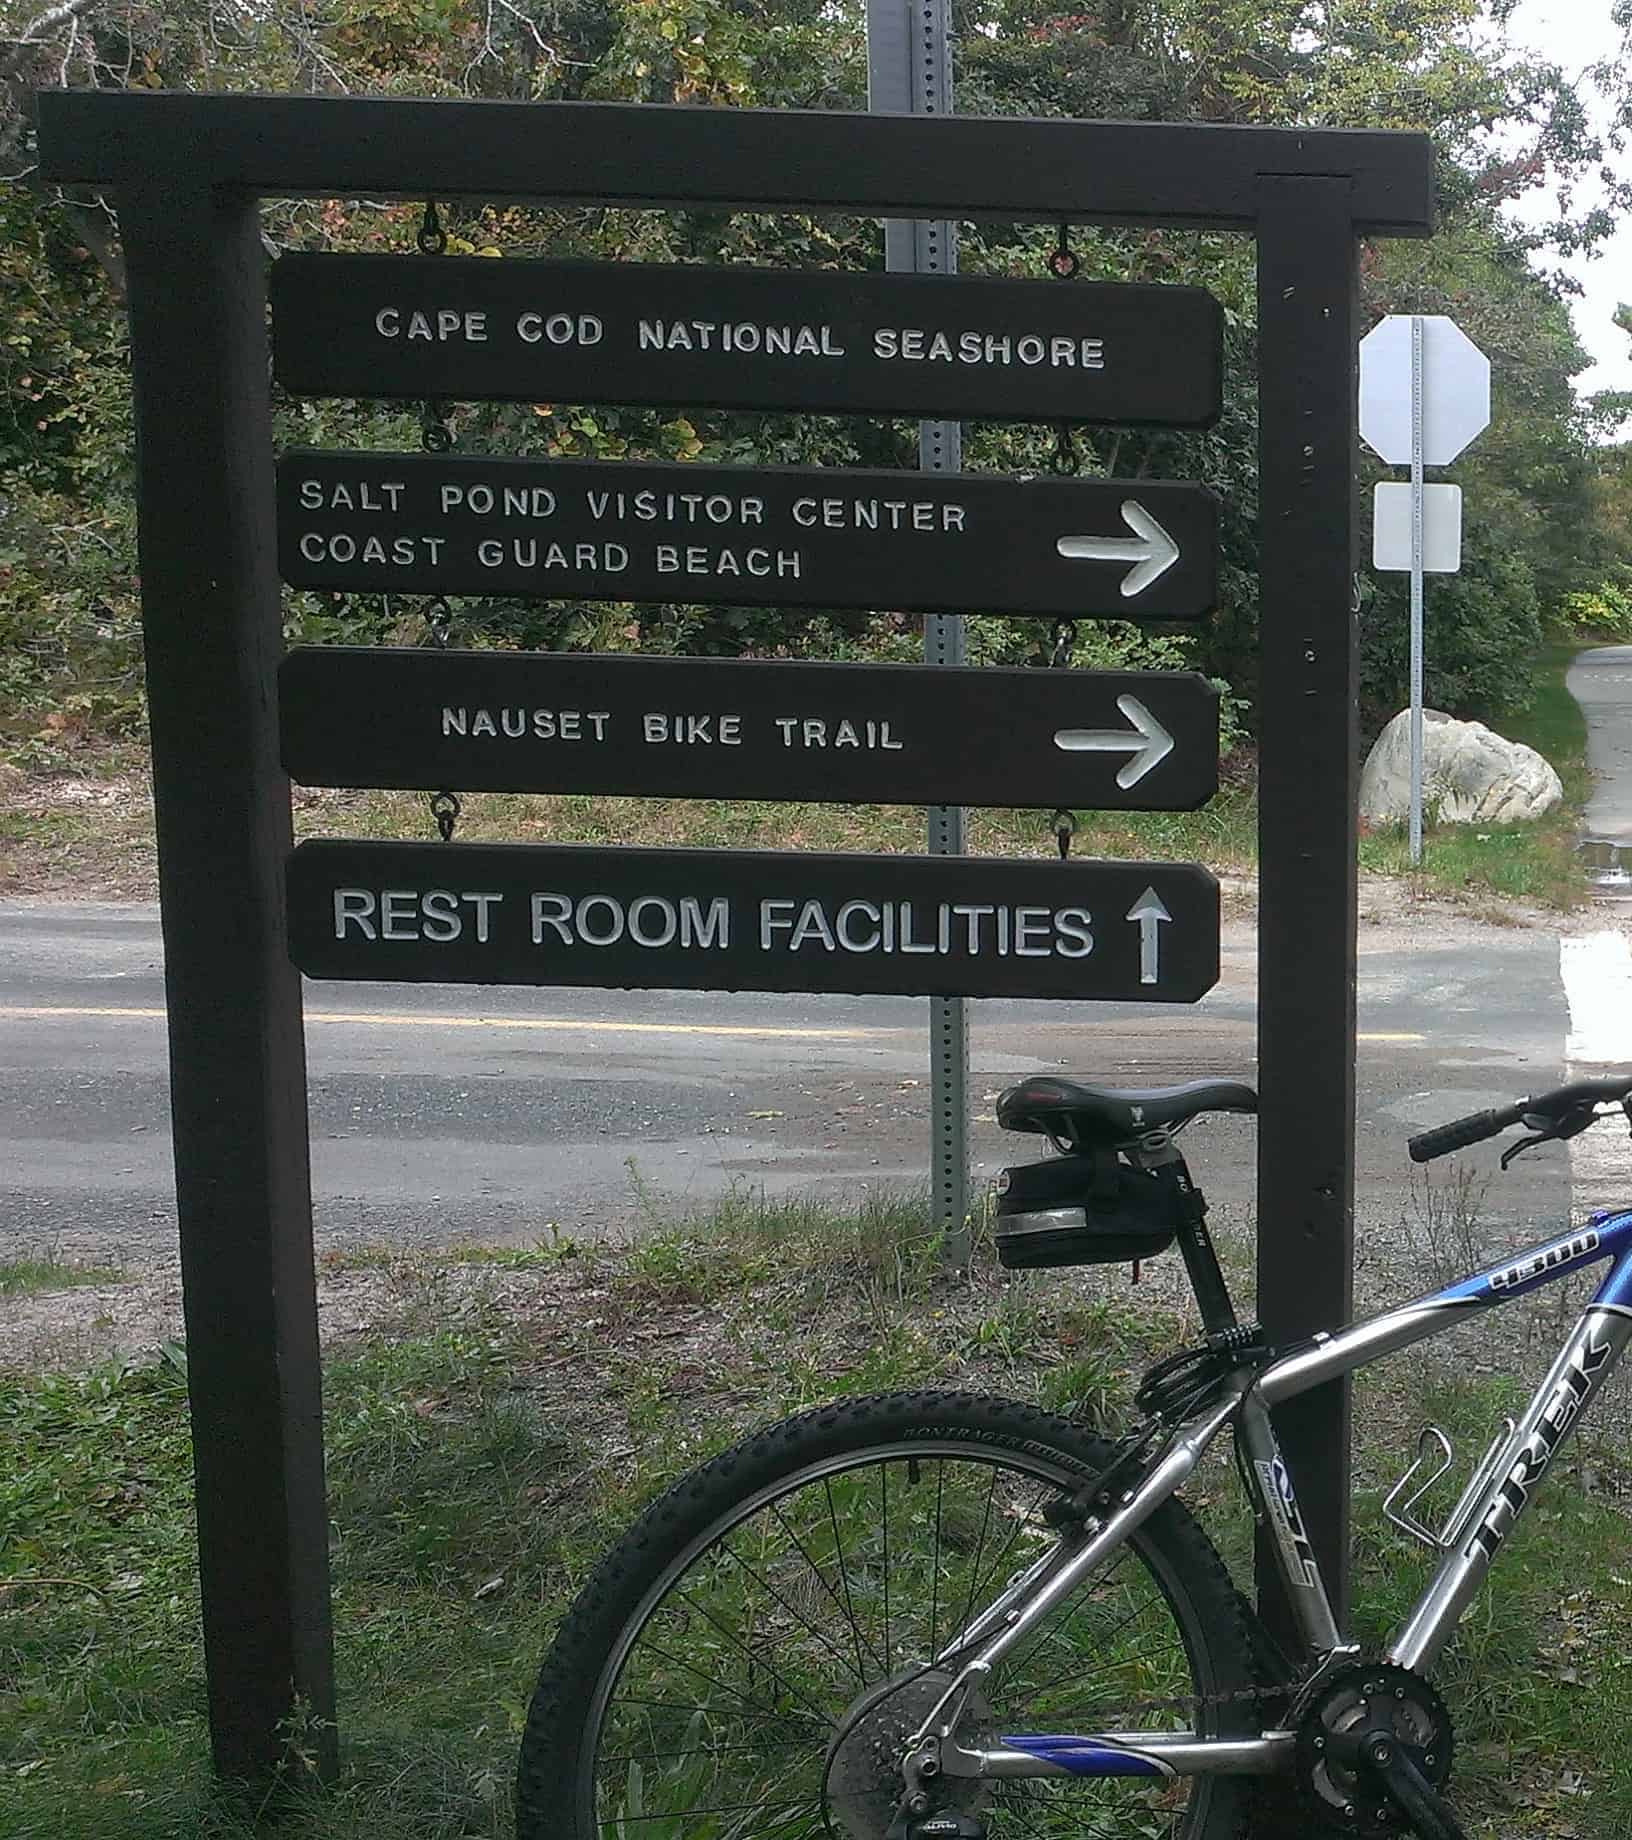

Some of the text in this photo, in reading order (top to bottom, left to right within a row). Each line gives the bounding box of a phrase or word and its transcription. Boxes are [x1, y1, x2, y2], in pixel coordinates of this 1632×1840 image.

[375, 309, 1105, 369] CAPE COD NATIONAL SEASHORE
[300, 481, 966, 532] SALT POND VISITOR CENTER
[300, 533, 801, 579] COAST GUARD BEACH
[442, 708, 903, 750] NAUSET BIKE TRAIL
[334, 890, 1094, 958] REST ROOM FACILITIES
[1488, 1231, 1599, 1289] 4300
[1464, 1331, 1611, 1562] TREK
